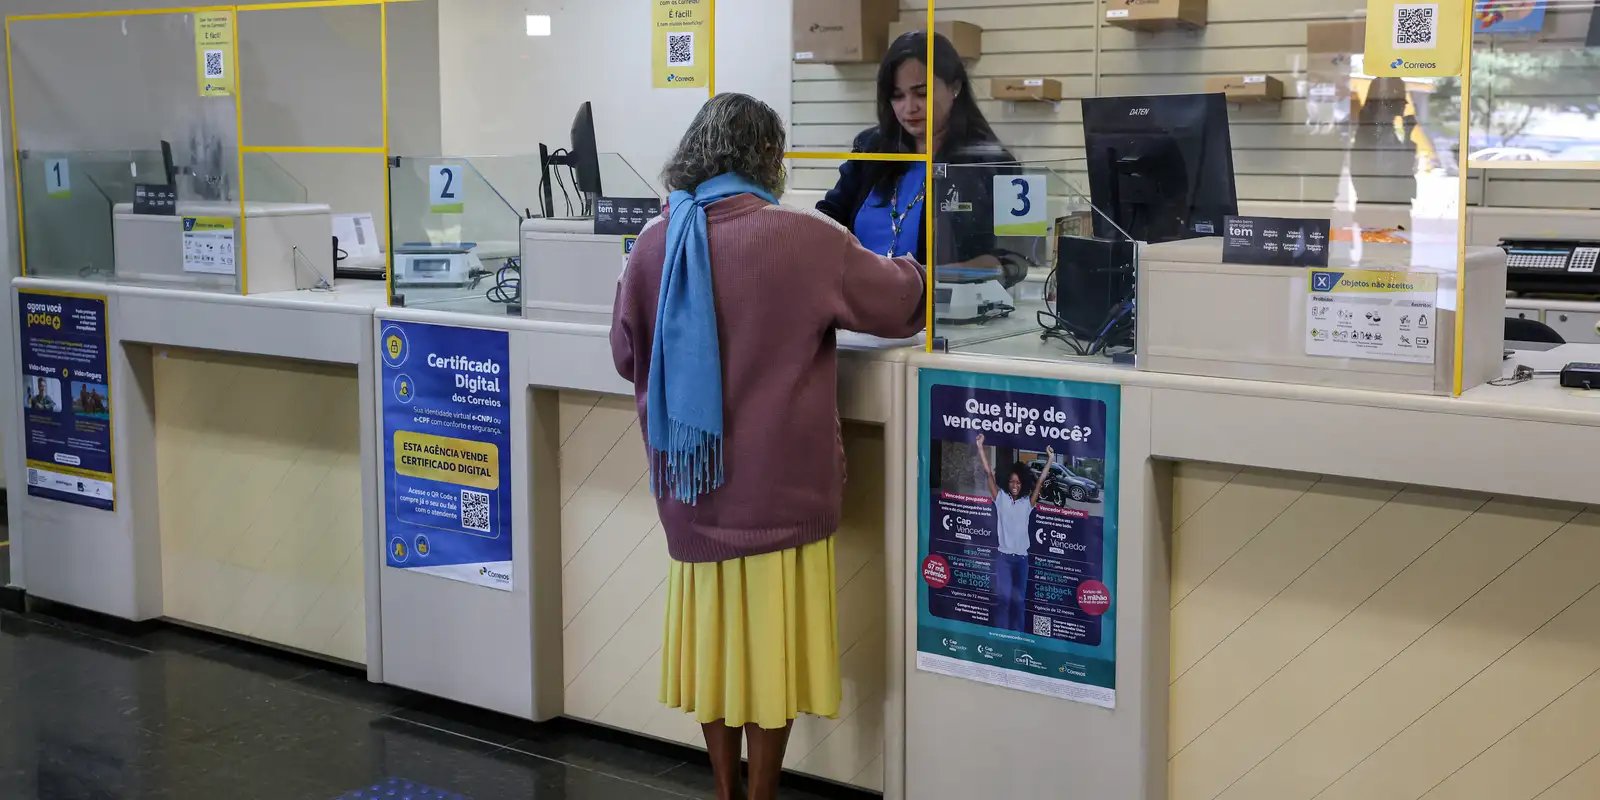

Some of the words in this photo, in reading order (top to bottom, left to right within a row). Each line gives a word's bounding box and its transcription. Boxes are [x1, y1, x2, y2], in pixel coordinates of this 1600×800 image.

[53, 162, 61, 187] 1
[440, 168, 454, 198] 2
[1010, 178, 1031, 216] 3
[1229, 227, 1253, 236] tem
[1341, 279, 1369, 288] Objetos
[27, 302, 46, 312] agora
[47, 304, 62, 313] você
[427, 353, 500, 374] Certificado
[455, 374, 500, 393] Digital
[452, 393, 466, 403] dos
[468, 395, 501, 408] Correios
[425, 407, 452, 418] identidade
[454, 411, 471, 420] virtual
[472, 414, 492, 423] e-CNPJ
[965, 398, 1000, 415] Que
[1005, 402, 1040, 423] tipo
[1044, 406, 1066, 423] de
[443, 420, 466, 430] conforto
[472, 424, 502, 435] segurança.
[942, 414, 1022, 435] vencedor
[1025, 420, 1036, 436] é
[1040, 425, 1092, 442] você?
[403, 442, 422, 453] ESTA
[424, 444, 459, 458] AGÊNCIA
[460, 451, 488, 463] VENDE
[401, 455, 456, 472] CERTIFICADO
[458, 465, 491, 478] DIGITAL
[408, 487, 426, 496] Acesse
[440, 492, 453, 501] Code
[400, 496, 419, 504] compre
[419, 497, 424, 505] já
[447, 502, 457, 510] fale
[431, 509, 457, 519] atendente
[956, 516, 971, 527] Cap
[957, 525, 991, 537] Vencedor
[1050, 530, 1066, 540] Cap
[1051, 539, 1086, 551] Vencedor
[488, 570, 509, 581] Correios
[924, 569, 947, 579] prêmios
[954, 569, 990, 581] Cashback
[970, 579, 990, 588] 100%
[1035, 583, 1072, 596] Cashback
[1046, 592, 1064, 601] 50%
